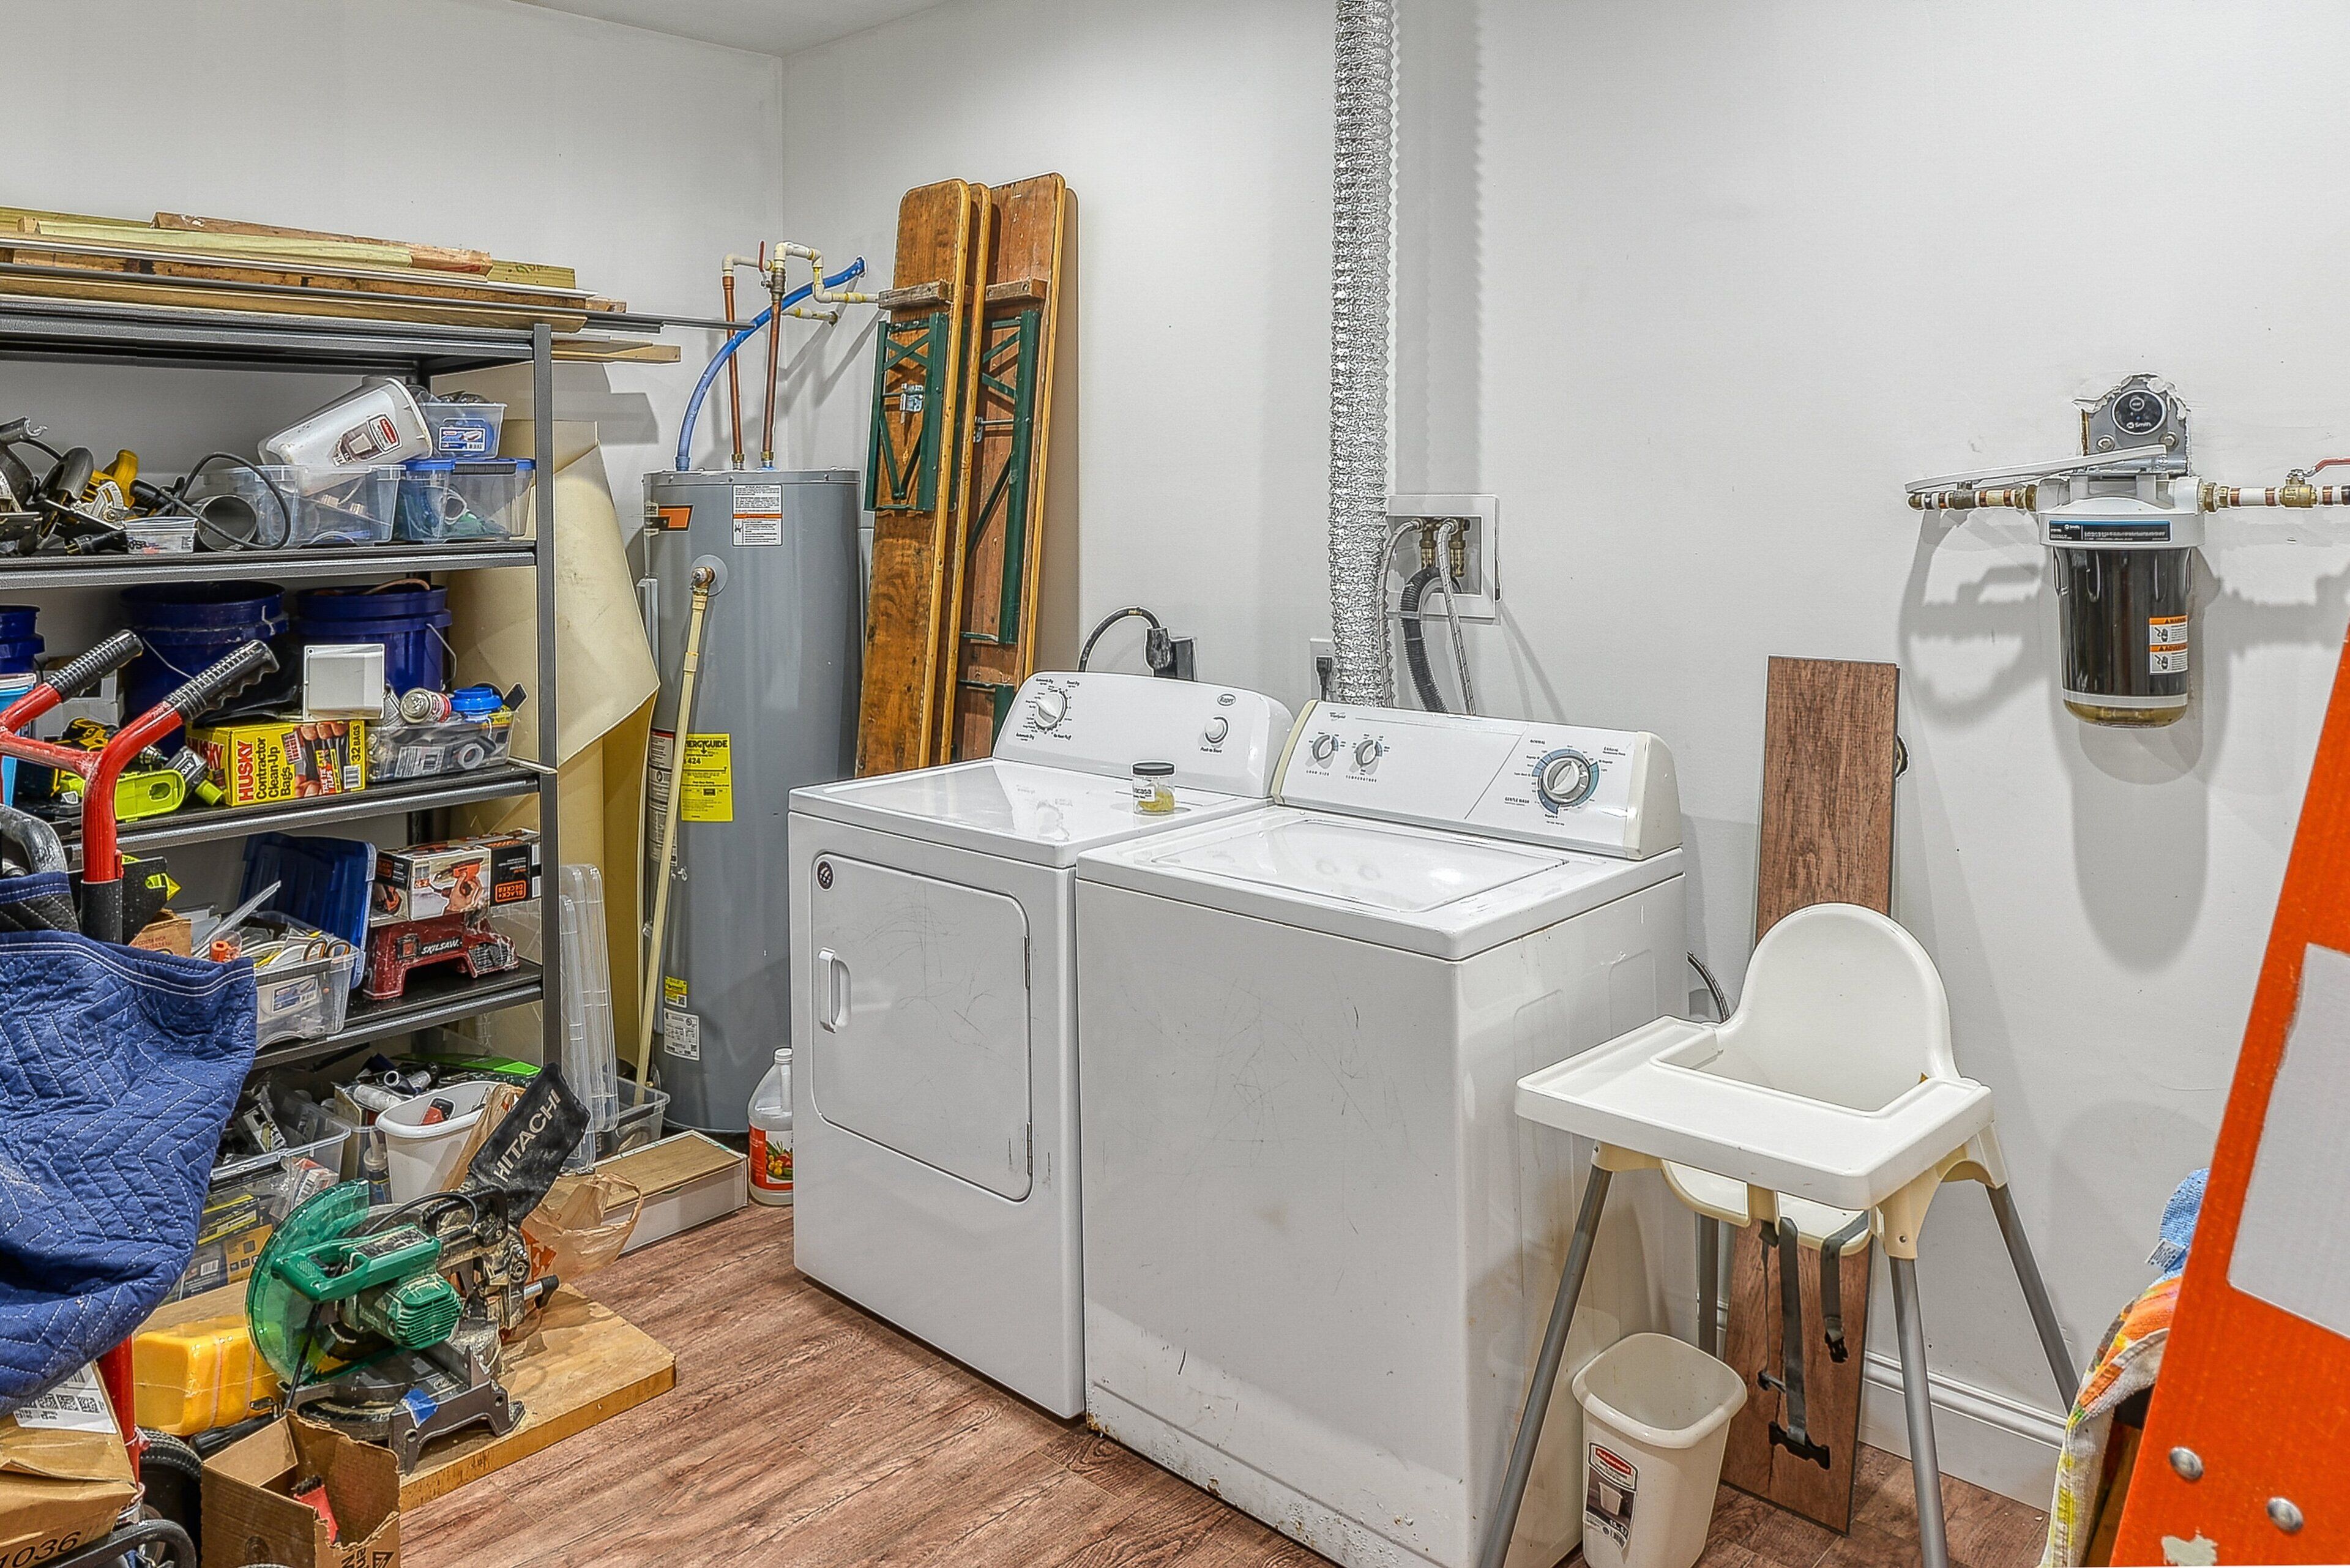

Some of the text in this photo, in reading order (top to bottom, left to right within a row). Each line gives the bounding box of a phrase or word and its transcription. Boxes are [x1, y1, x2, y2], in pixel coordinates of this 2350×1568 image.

[256, 736, 267, 800] Contractor
[351, 725, 361, 763] 32 BAGS
[685, 739, 728, 749] ERGYGUIDE
[237, 740, 254, 802] HUSKY
[268, 745, 281, 798] Clean-Up
[280, 766, 294, 796] Bags
[493, 1089, 561, 1182] HITACHI
